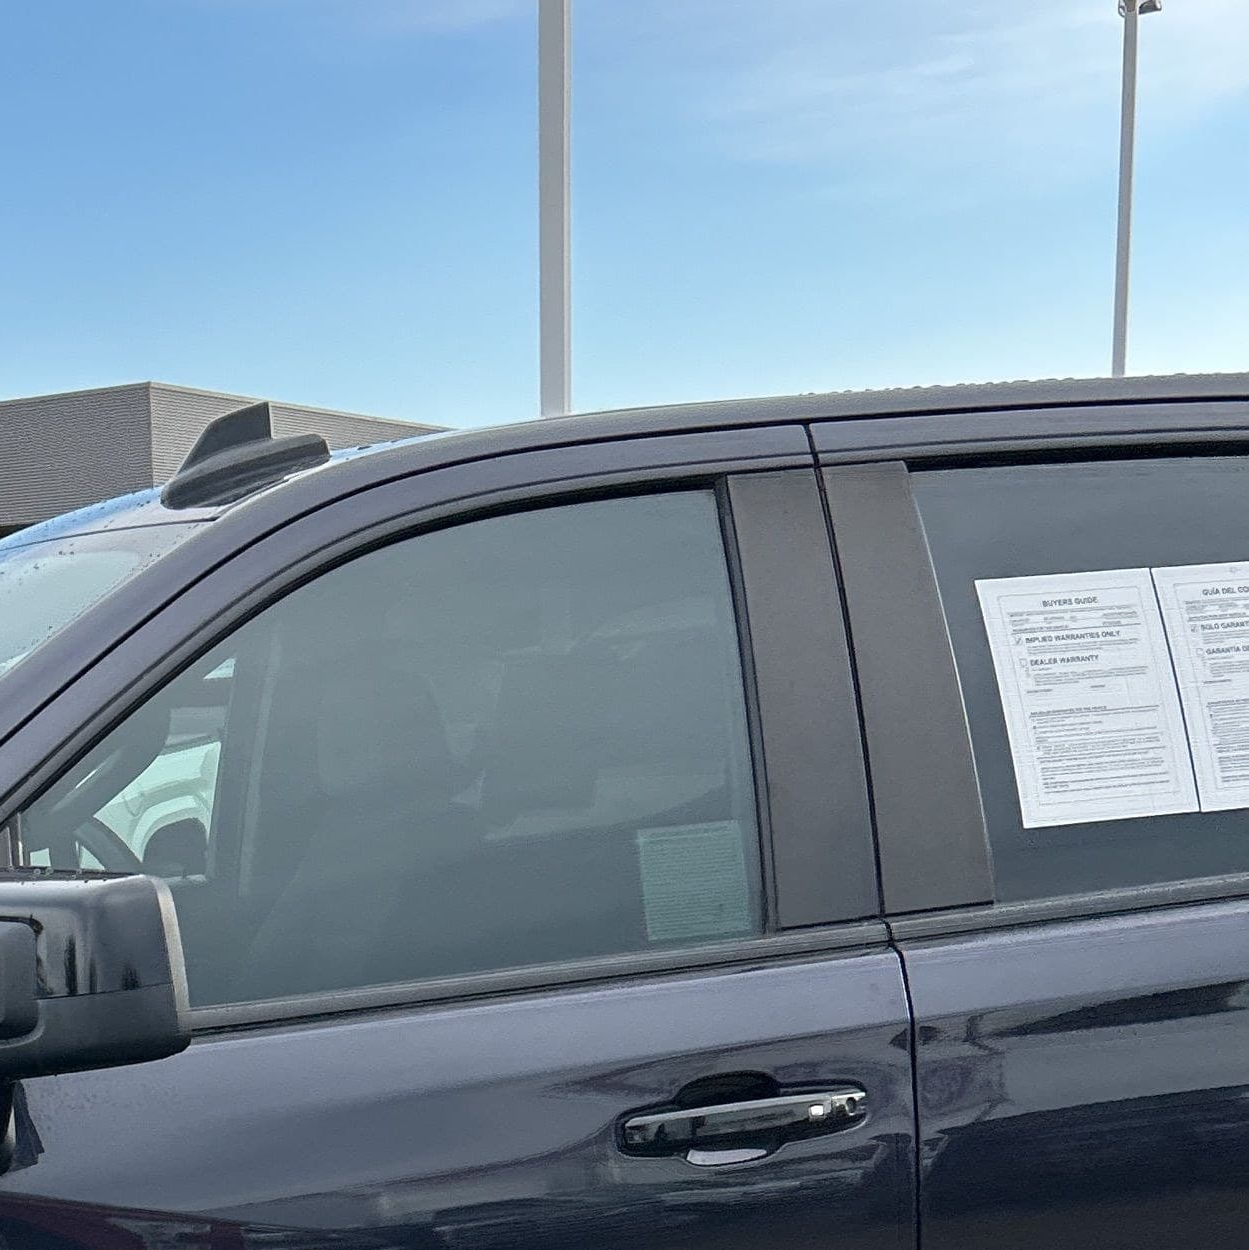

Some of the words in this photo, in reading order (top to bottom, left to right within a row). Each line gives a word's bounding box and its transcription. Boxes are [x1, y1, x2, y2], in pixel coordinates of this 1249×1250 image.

[1042, 598, 1072, 607] BUYERS
[1074, 596, 1098, 605] GUIDE
[1102, 630, 1120, 638] ONLY
[1030, 658, 1057, 666] DEALER
[1060, 654, 1099, 663] WARRANTY
